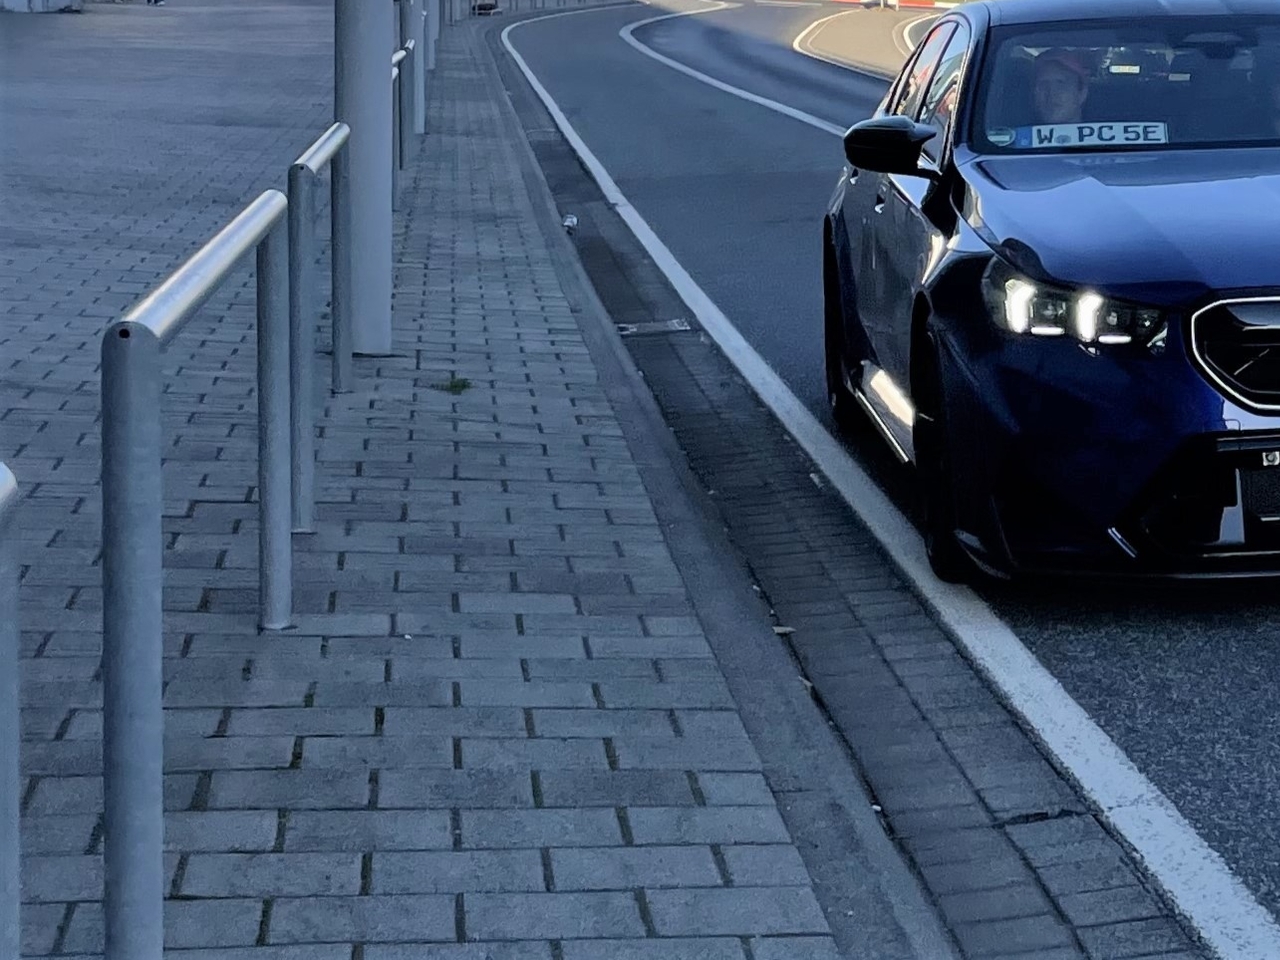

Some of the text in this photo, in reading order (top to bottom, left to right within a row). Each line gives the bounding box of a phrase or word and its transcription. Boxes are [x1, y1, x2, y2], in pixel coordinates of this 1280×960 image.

[1036, 125, 1162, 145] W PC 5E
